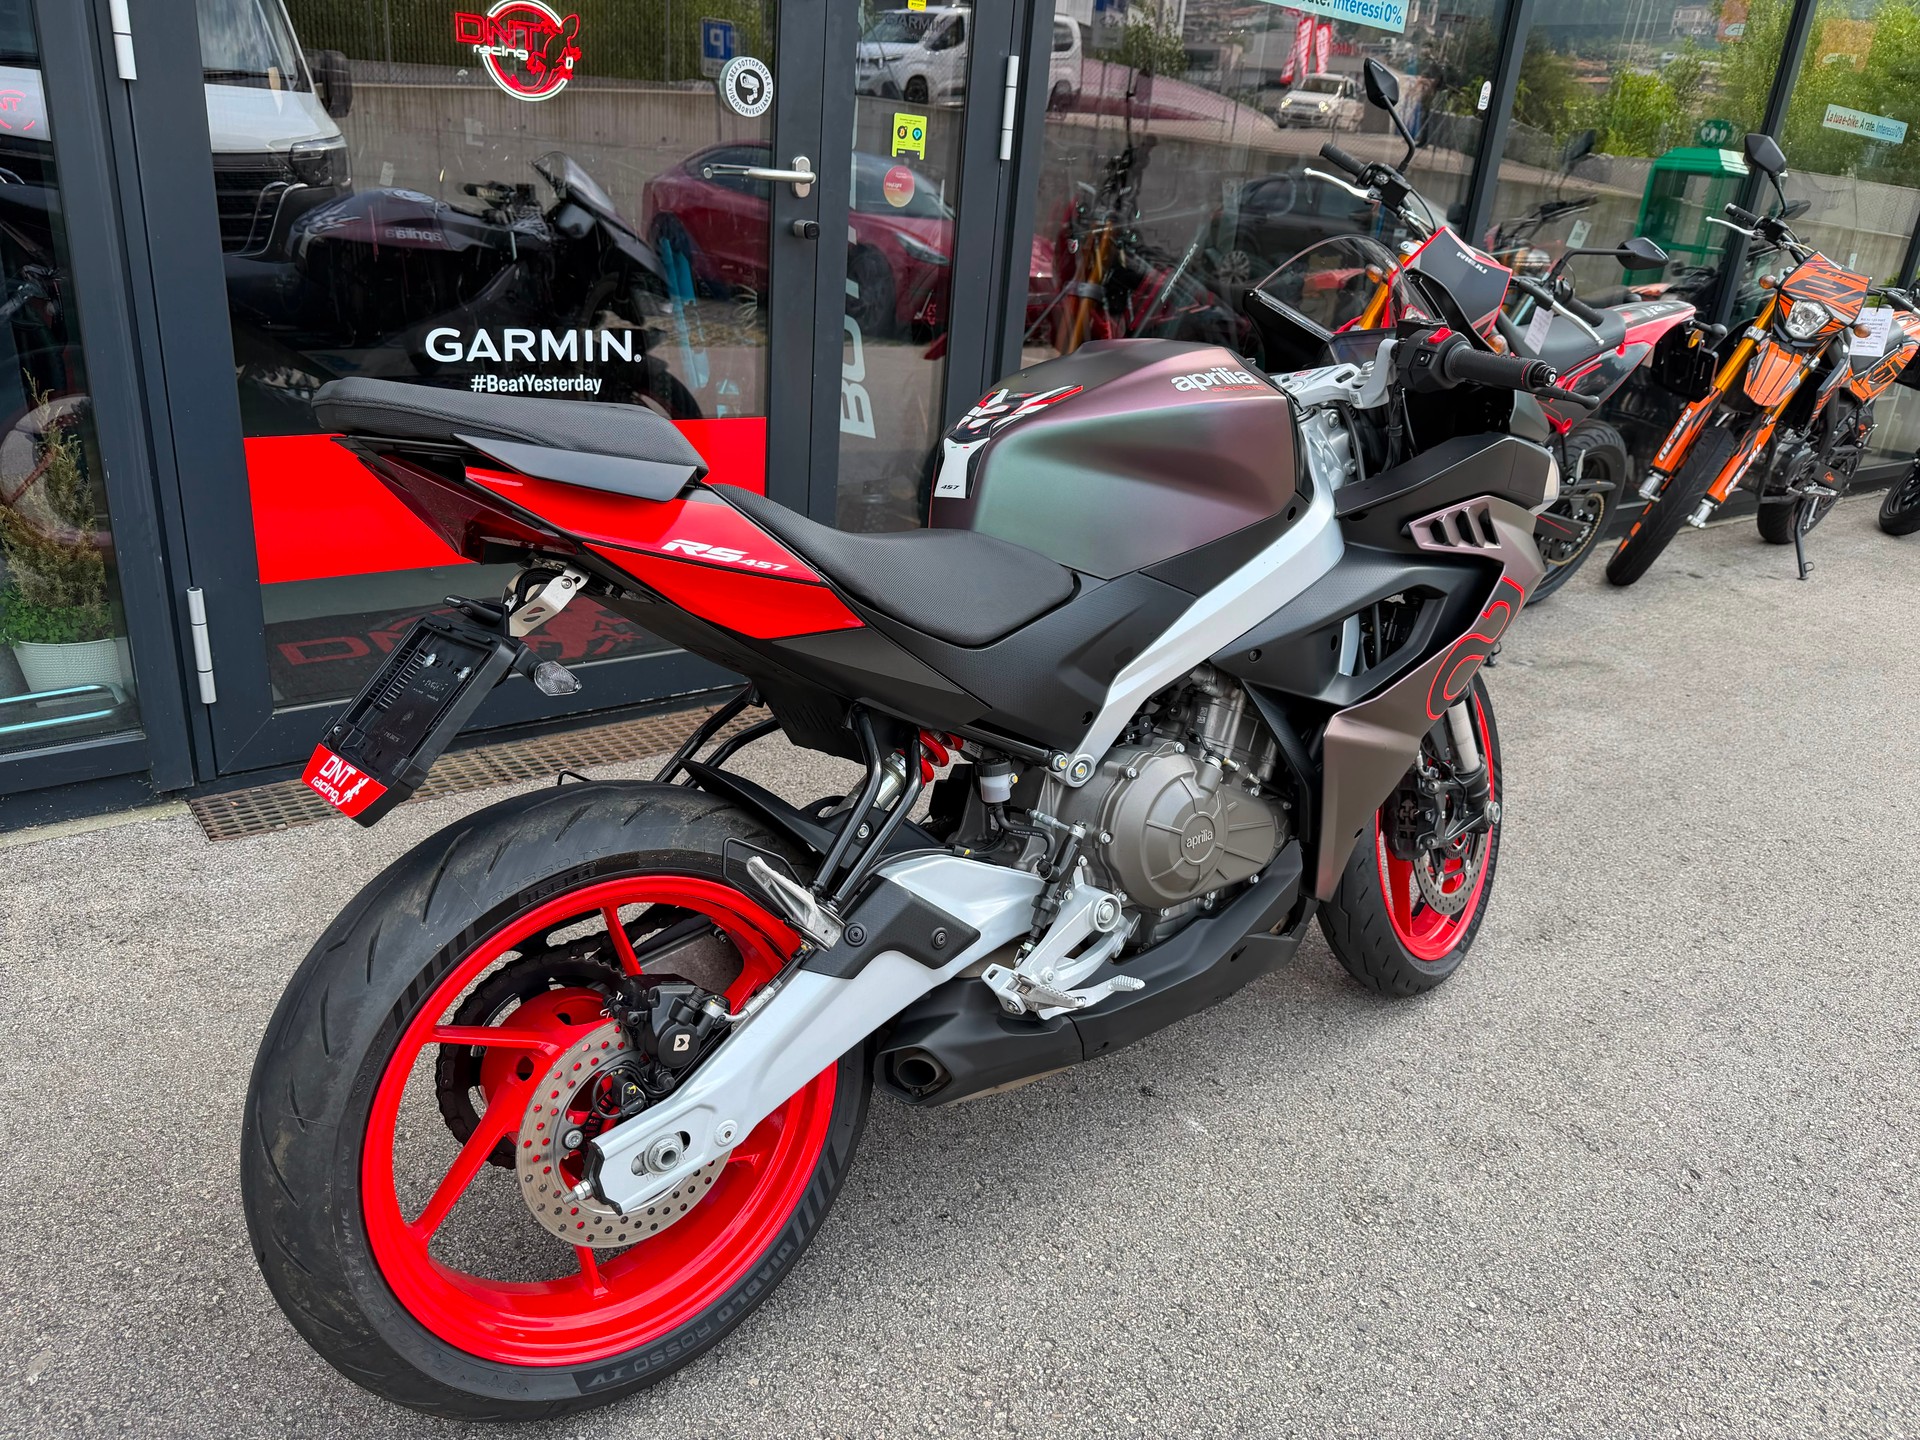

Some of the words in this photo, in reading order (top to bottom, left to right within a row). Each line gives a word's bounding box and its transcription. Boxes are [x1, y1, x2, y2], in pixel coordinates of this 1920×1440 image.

[1333, 0, 1384, 19] Interessi
[1385, 4, 1402, 24] 0%
[455, 12, 541, 50] DNT
[473, 44, 529, 61] racing
[425, 327, 632, 362] GARMIN
[470, 374, 602, 395] #BeatYesterday
[1171, 367, 1259, 391] aprilia
[661, 539, 749, 562] RS
[737, 559, 789, 571] 457
[319, 755, 357, 787] DNT
[311, 776, 340, 803] racing
[1186, 829, 1213, 849] aprilia
[716, 1239, 796, 1322] DIABLO
[633, 1323, 711, 1373] ROSSO
